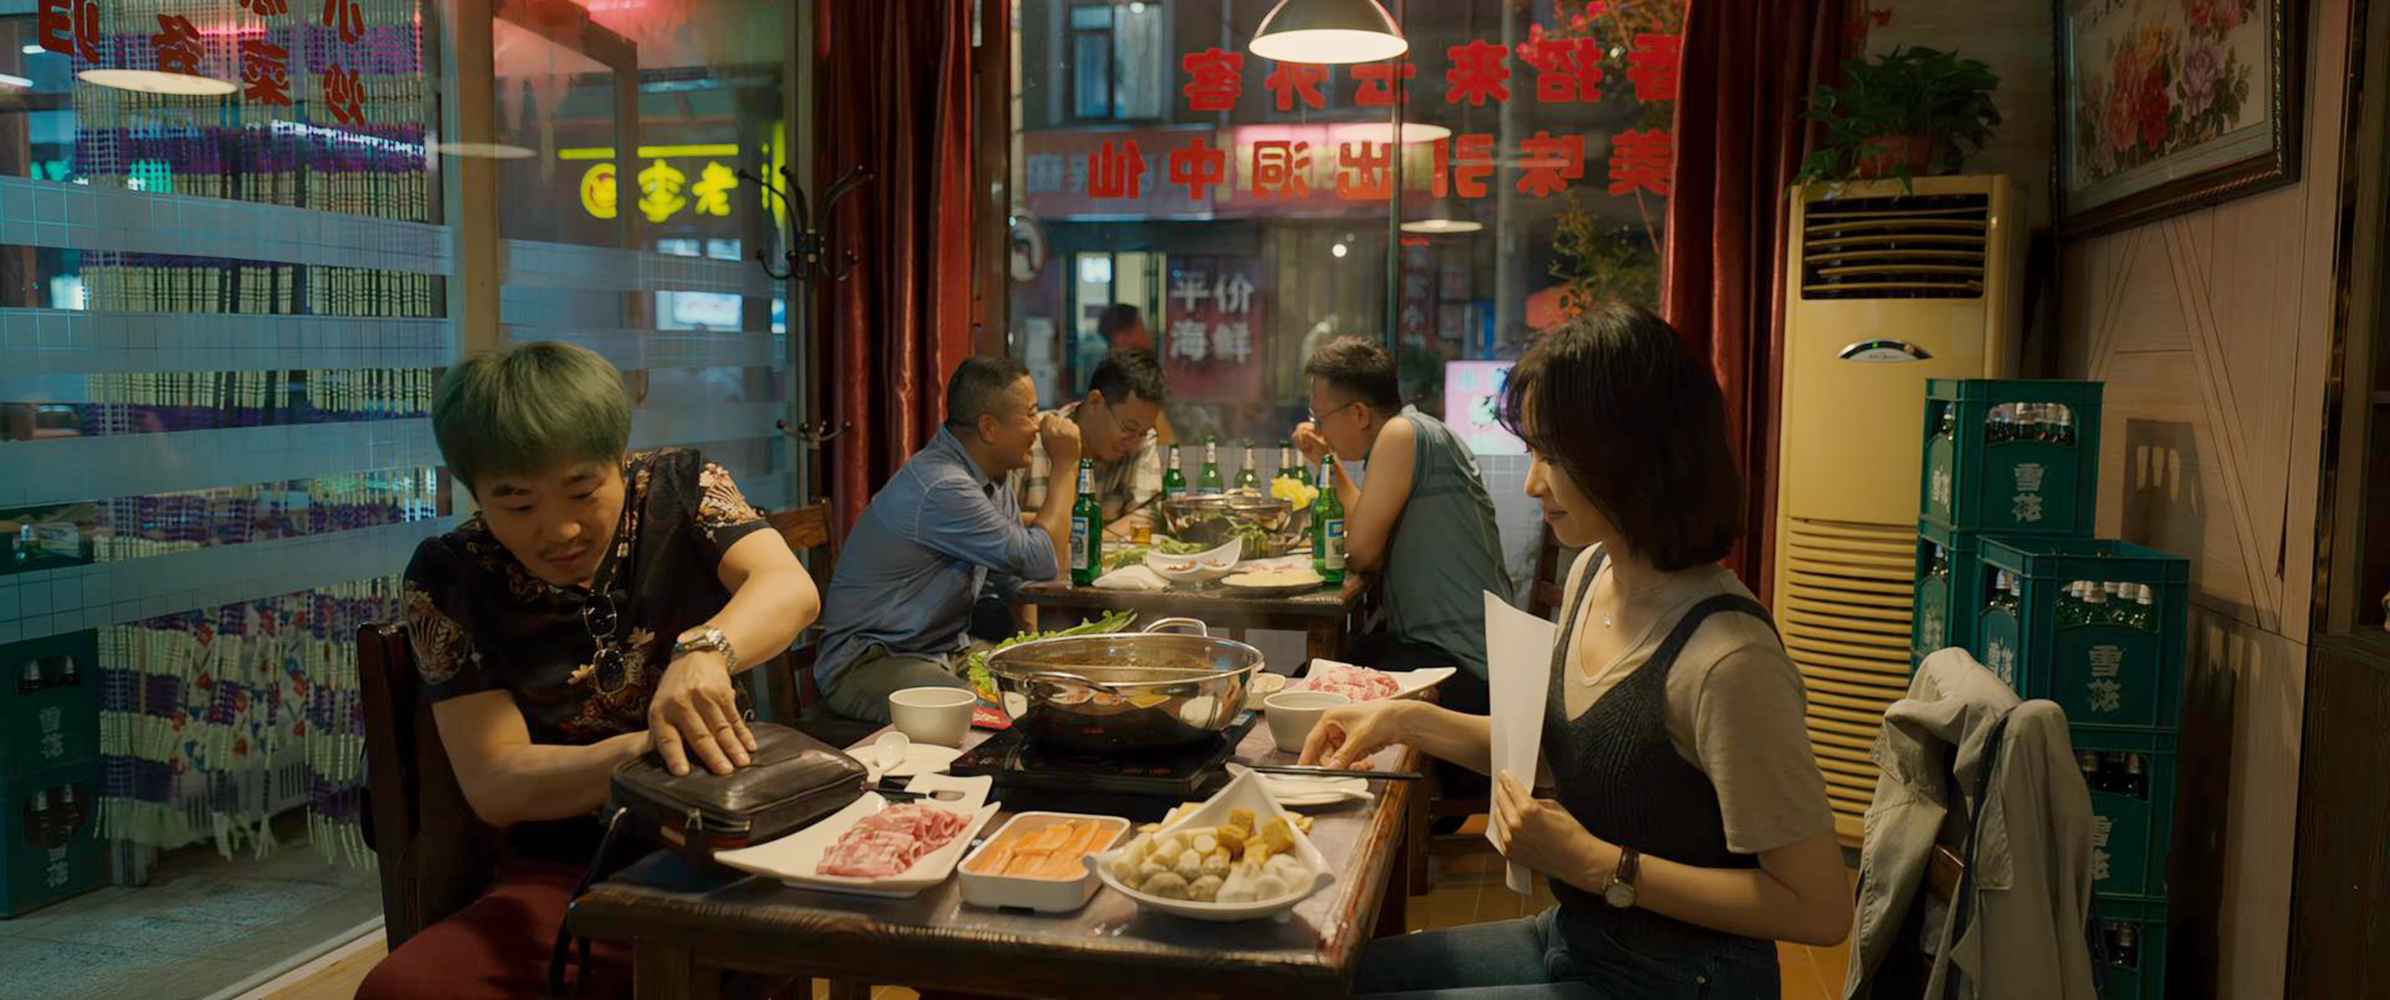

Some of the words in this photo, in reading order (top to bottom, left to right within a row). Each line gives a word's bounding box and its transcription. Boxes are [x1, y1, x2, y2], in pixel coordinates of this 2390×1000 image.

[1170, 271, 1254, 313] 平价
[1169, 318, 1252, 364] 海鲜
[2012, 461, 2046, 523] 雪花
[2086, 643, 2125, 713] 雪花
